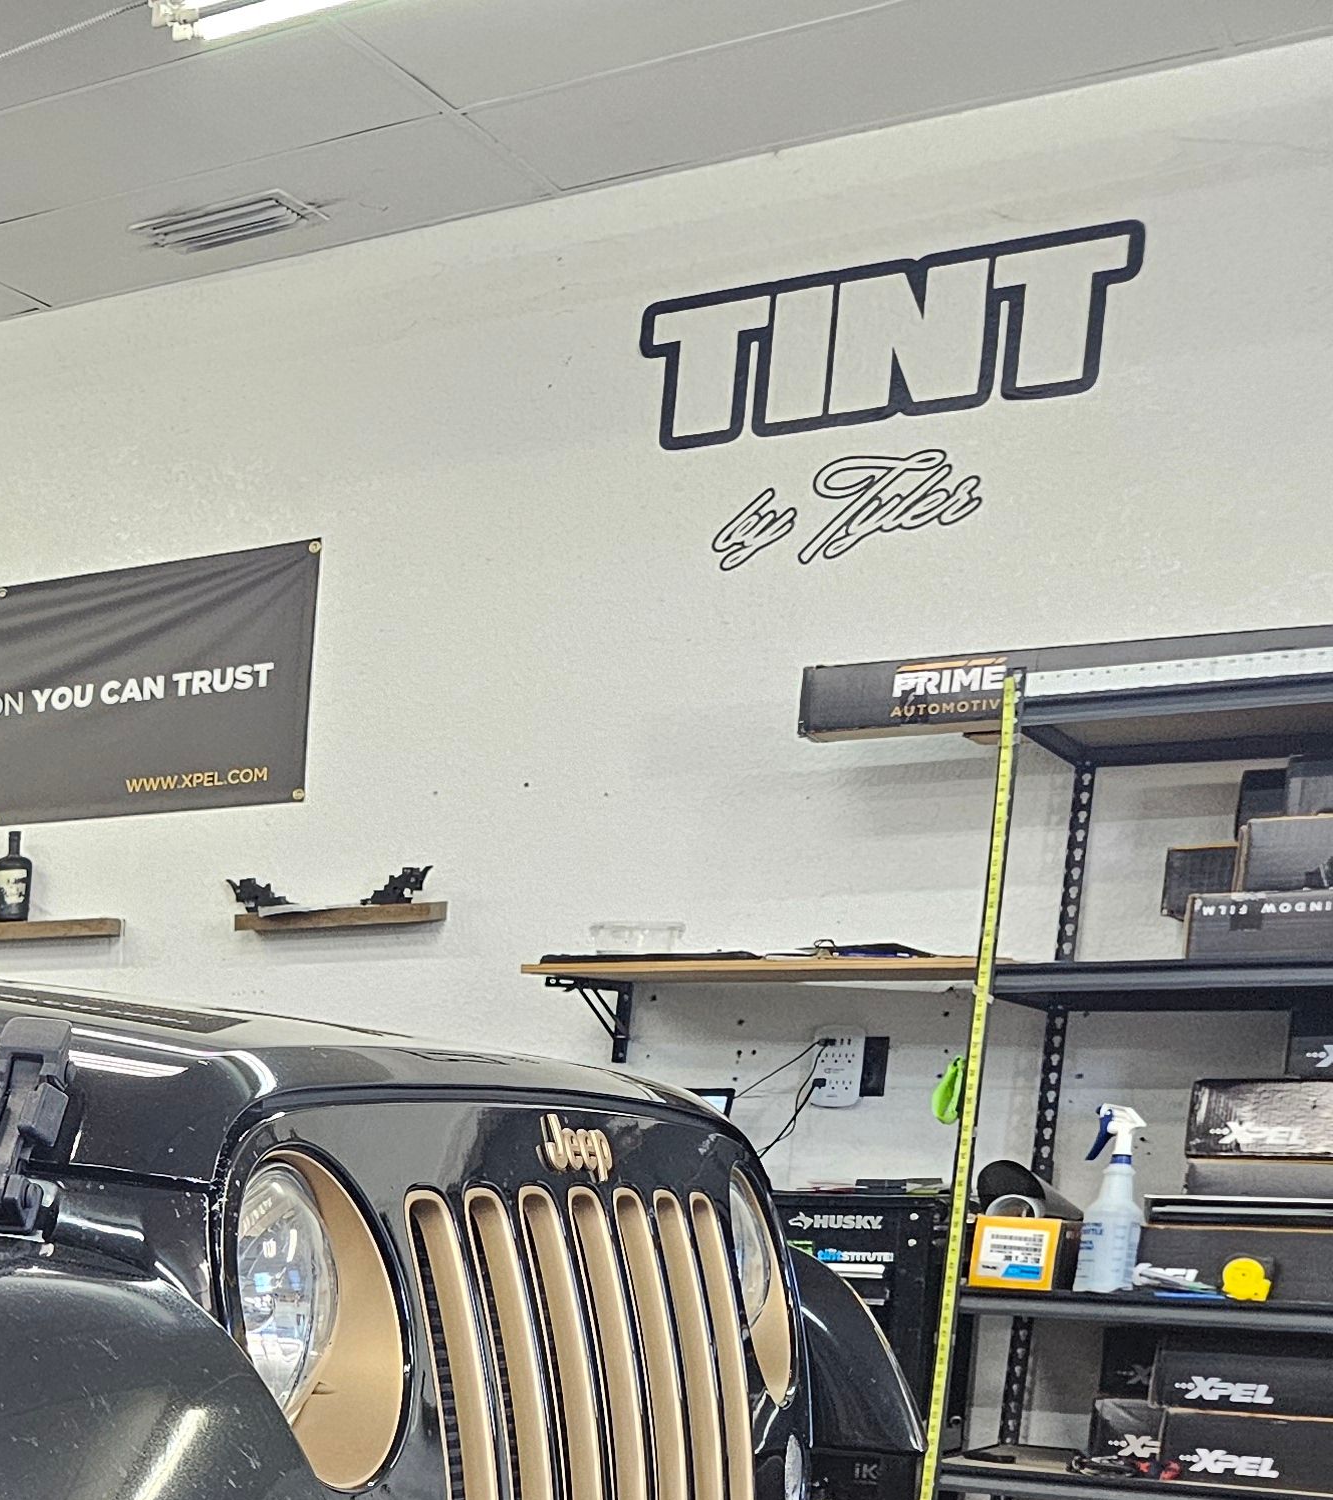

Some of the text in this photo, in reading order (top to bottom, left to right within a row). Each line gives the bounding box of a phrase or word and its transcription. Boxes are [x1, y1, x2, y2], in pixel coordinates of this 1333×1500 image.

[640, 219, 1145, 450] TINT
[712, 449, 983, 571] by Tyler
[32, 683, 94, 713] YOU
[100, 675, 165, 705] CAN
[172, 662, 275, 697] TRUST
[892, 665, 1007, 698] PRIME
[890, 699, 1001, 718] AUTOMOTIV
[125, 767, 269, 793] WWW.XPEL.COM
[1202, 901, 1332, 917] INDOW FILM
[536, 1113, 613, 1182] Jeep
[813, 1214, 884, 1230] HUSKY
[1184, 1376, 1275, 1405] XPEL
[1189, 1448, 1280, 1479] XPEL
